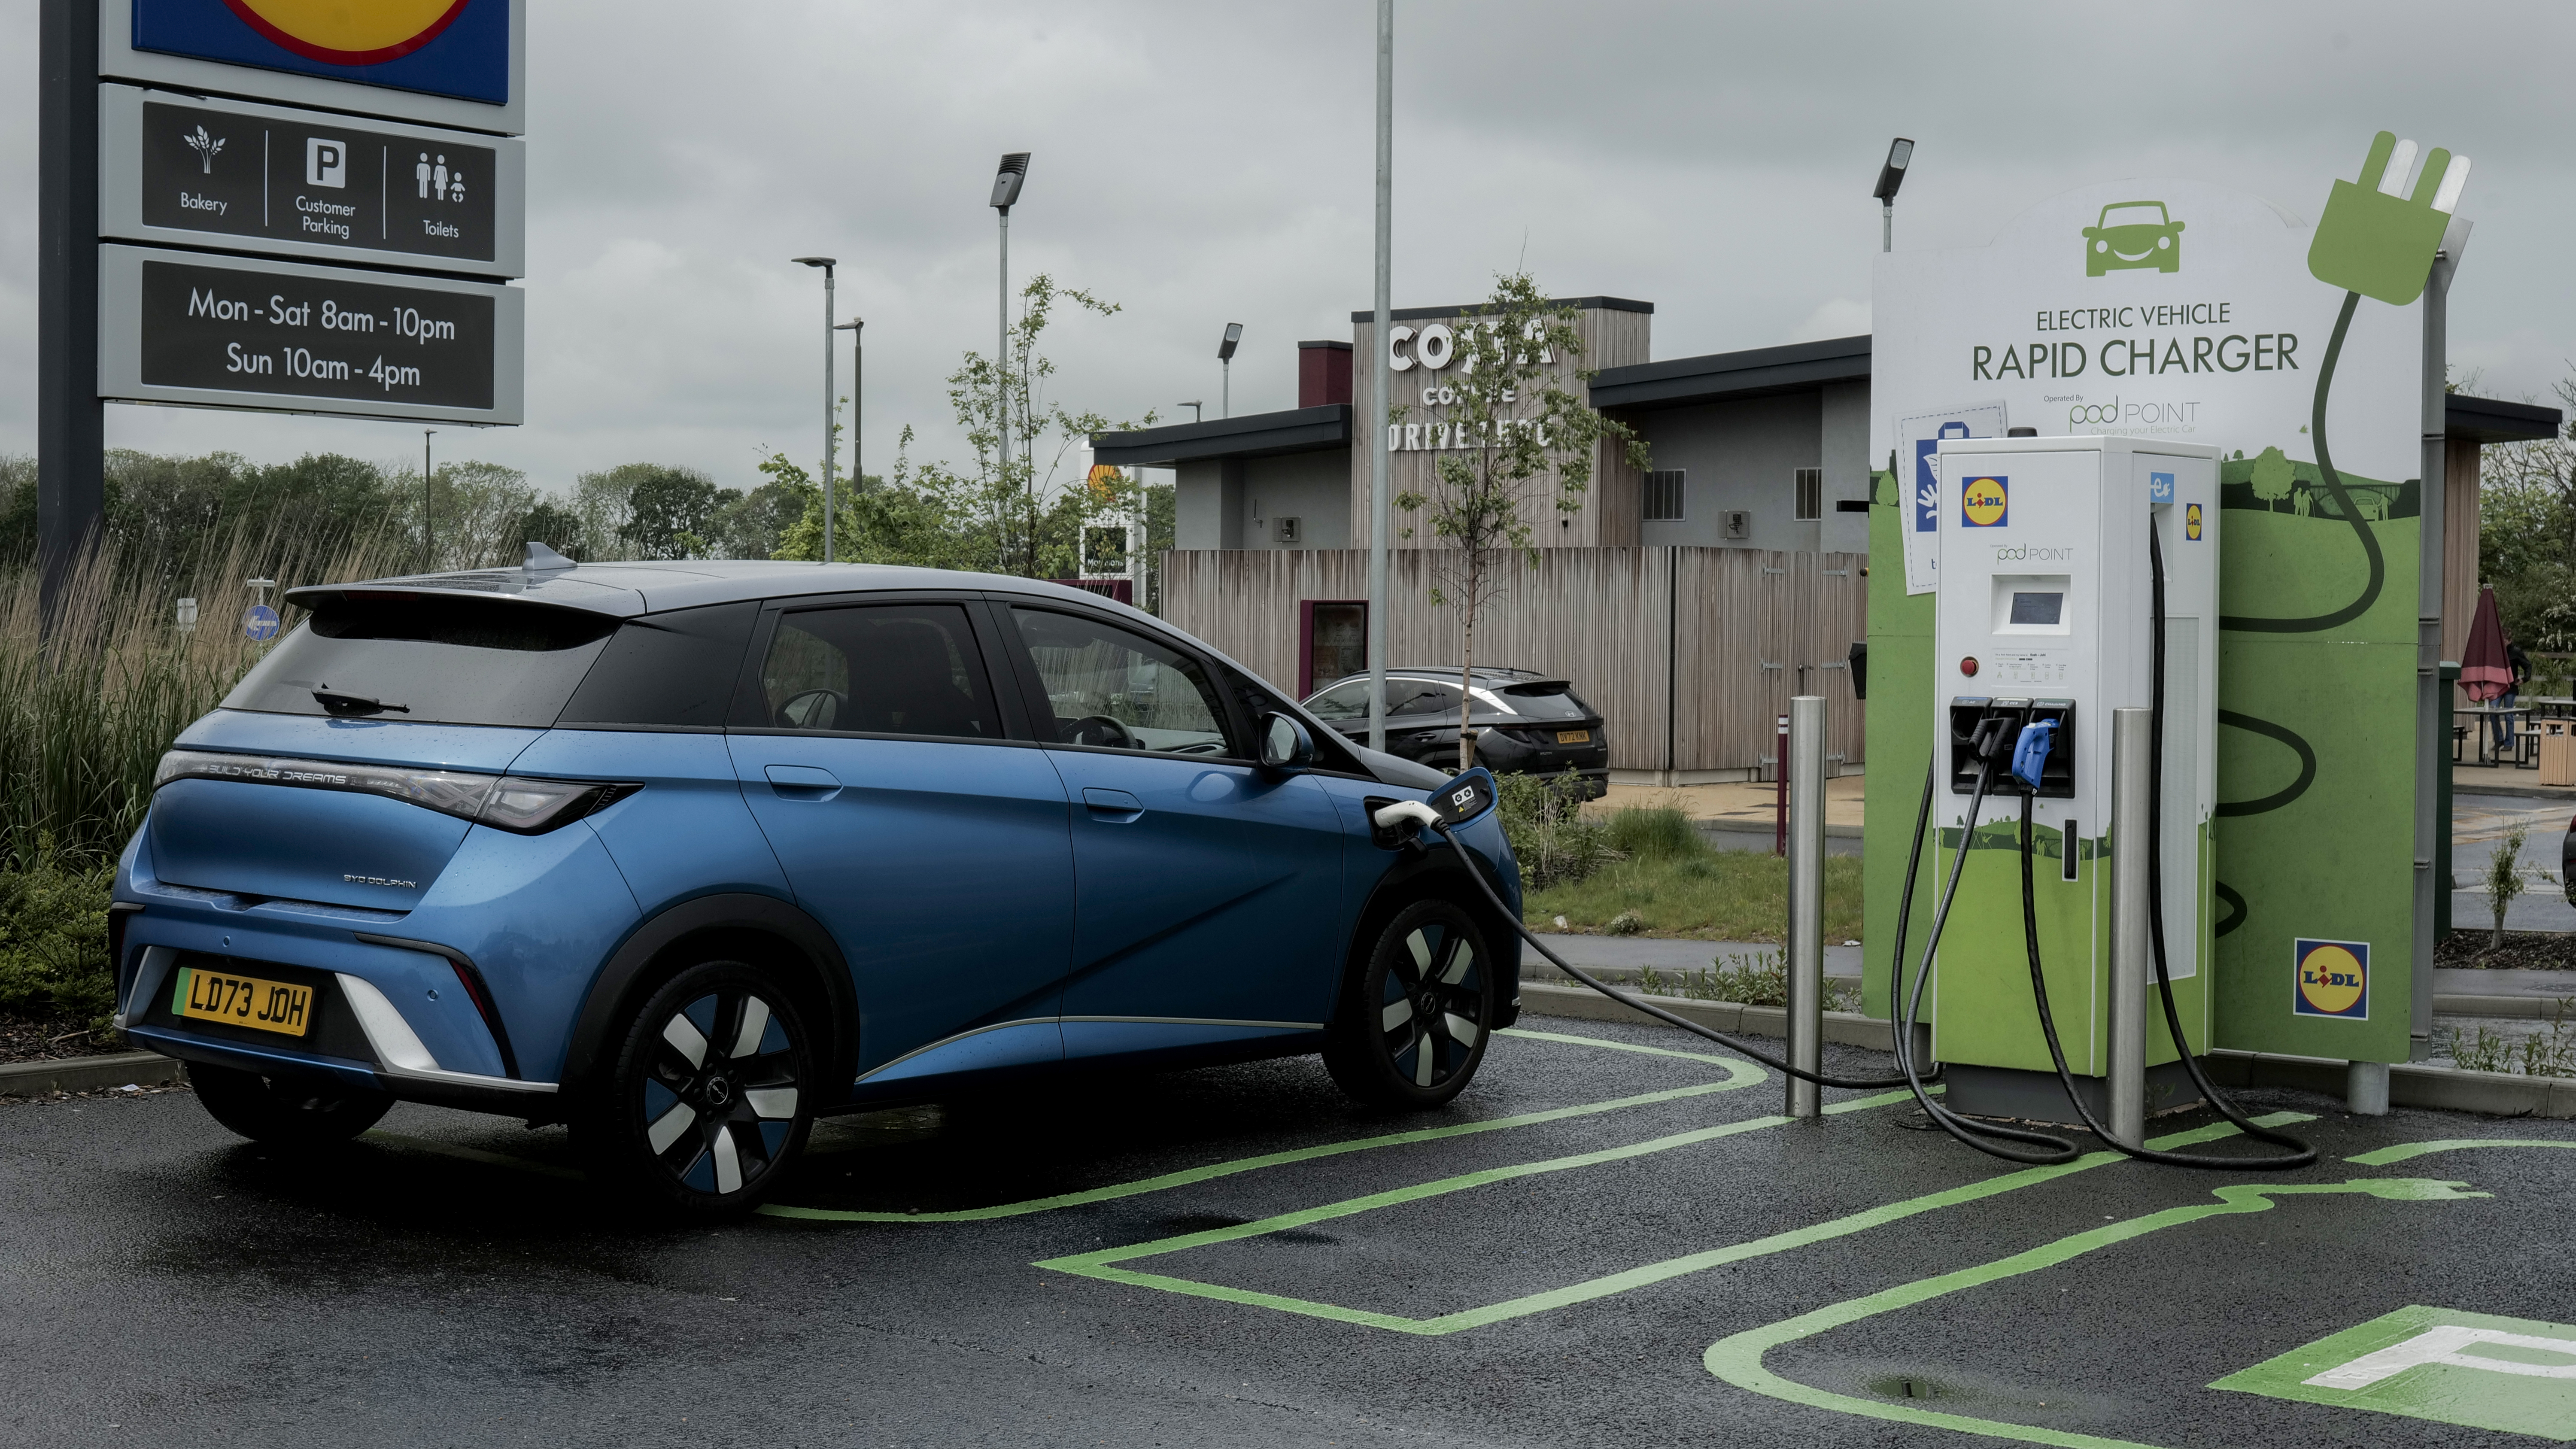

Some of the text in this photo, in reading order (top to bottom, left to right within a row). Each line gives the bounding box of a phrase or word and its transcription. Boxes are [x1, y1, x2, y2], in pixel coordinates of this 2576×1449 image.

[181, 192, 227, 216] Bakery
[296, 196, 355, 216] Customer
[303, 216, 349, 239] Parking
[423, 219, 459, 238] Toilets
[188, 286, 248, 321] Mon
[269, 295, 310, 326] Sat
[321, 300, 374, 332] 8am
[393, 307, 455, 344] 10pm
[2037, 302, 2230, 331] ELECTRIC VEHICLE
[227, 342, 272, 374] Sun
[283, 347, 349, 380] 10am
[368, 355, 420, 391] 4pm
[1973, 333, 2300, 381] RAPID CHARGER
[2044, 395, 2074, 403] Operated
[2069, 395, 2200, 434] pod POINT
[2091, 426, 2128, 436] Charging
[2151, 425, 2180, 434] Electric
[1997, 543, 2073, 565] pod POINT
[209, 765, 346, 784] BUILD YOUR DREAMS
[344, 875, 416, 889] BYD DOLPHIN
[190, 974, 254, 1017] LD73
